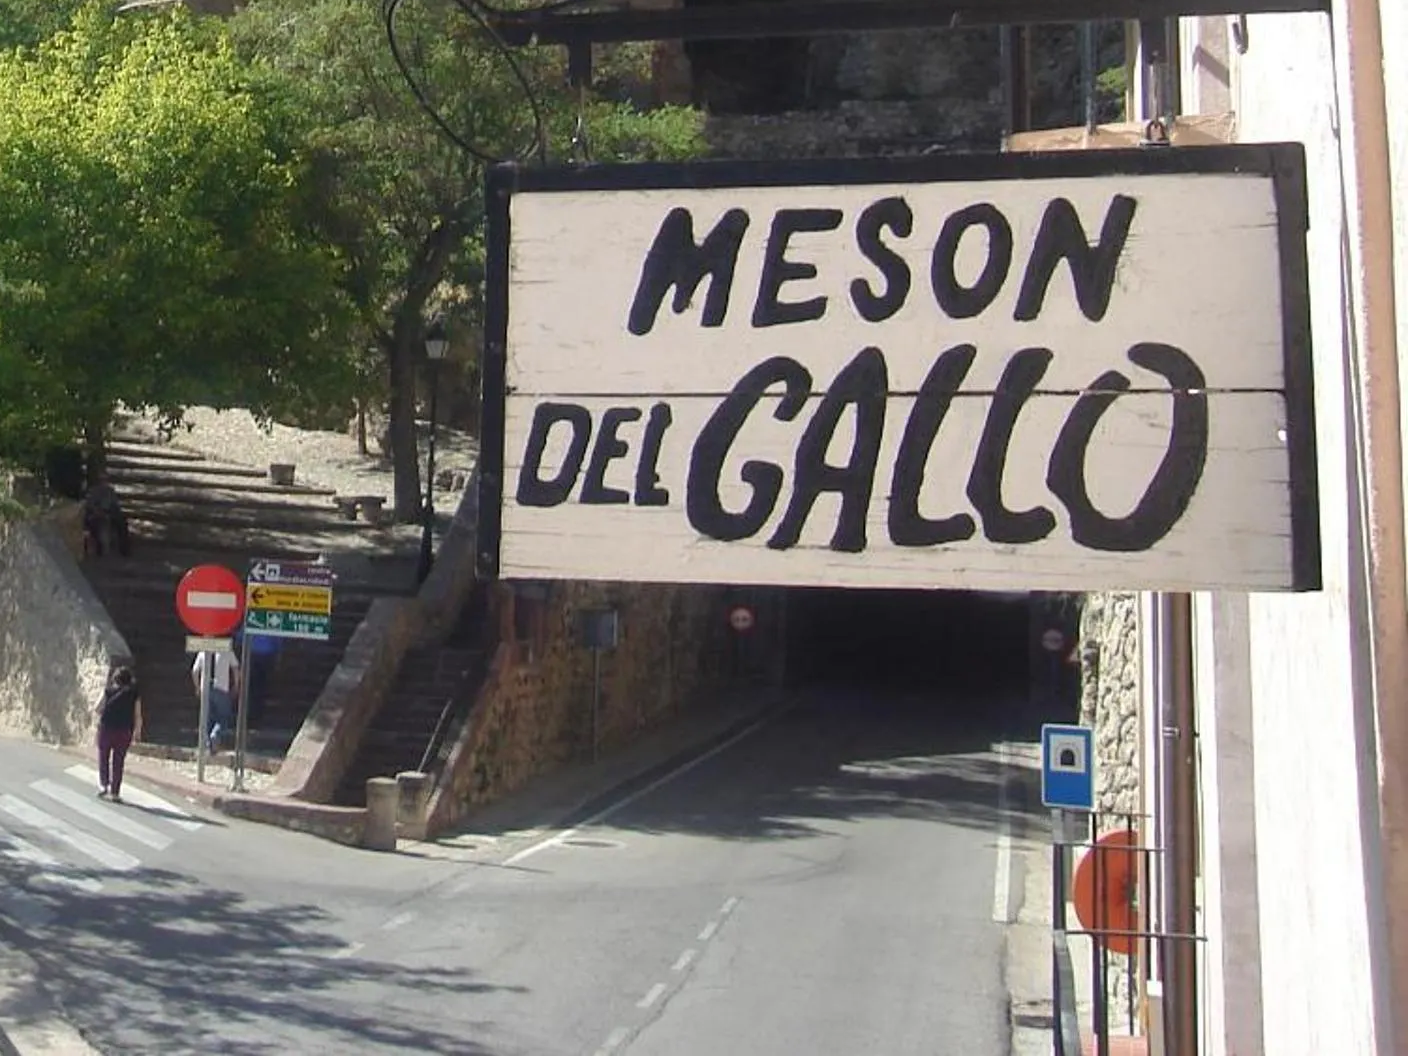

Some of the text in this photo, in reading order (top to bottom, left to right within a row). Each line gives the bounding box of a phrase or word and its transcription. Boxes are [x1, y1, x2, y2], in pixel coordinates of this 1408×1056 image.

[628, 195, 1138, 336] MESON
[515, 343, 1209, 554] DEL GALLO
